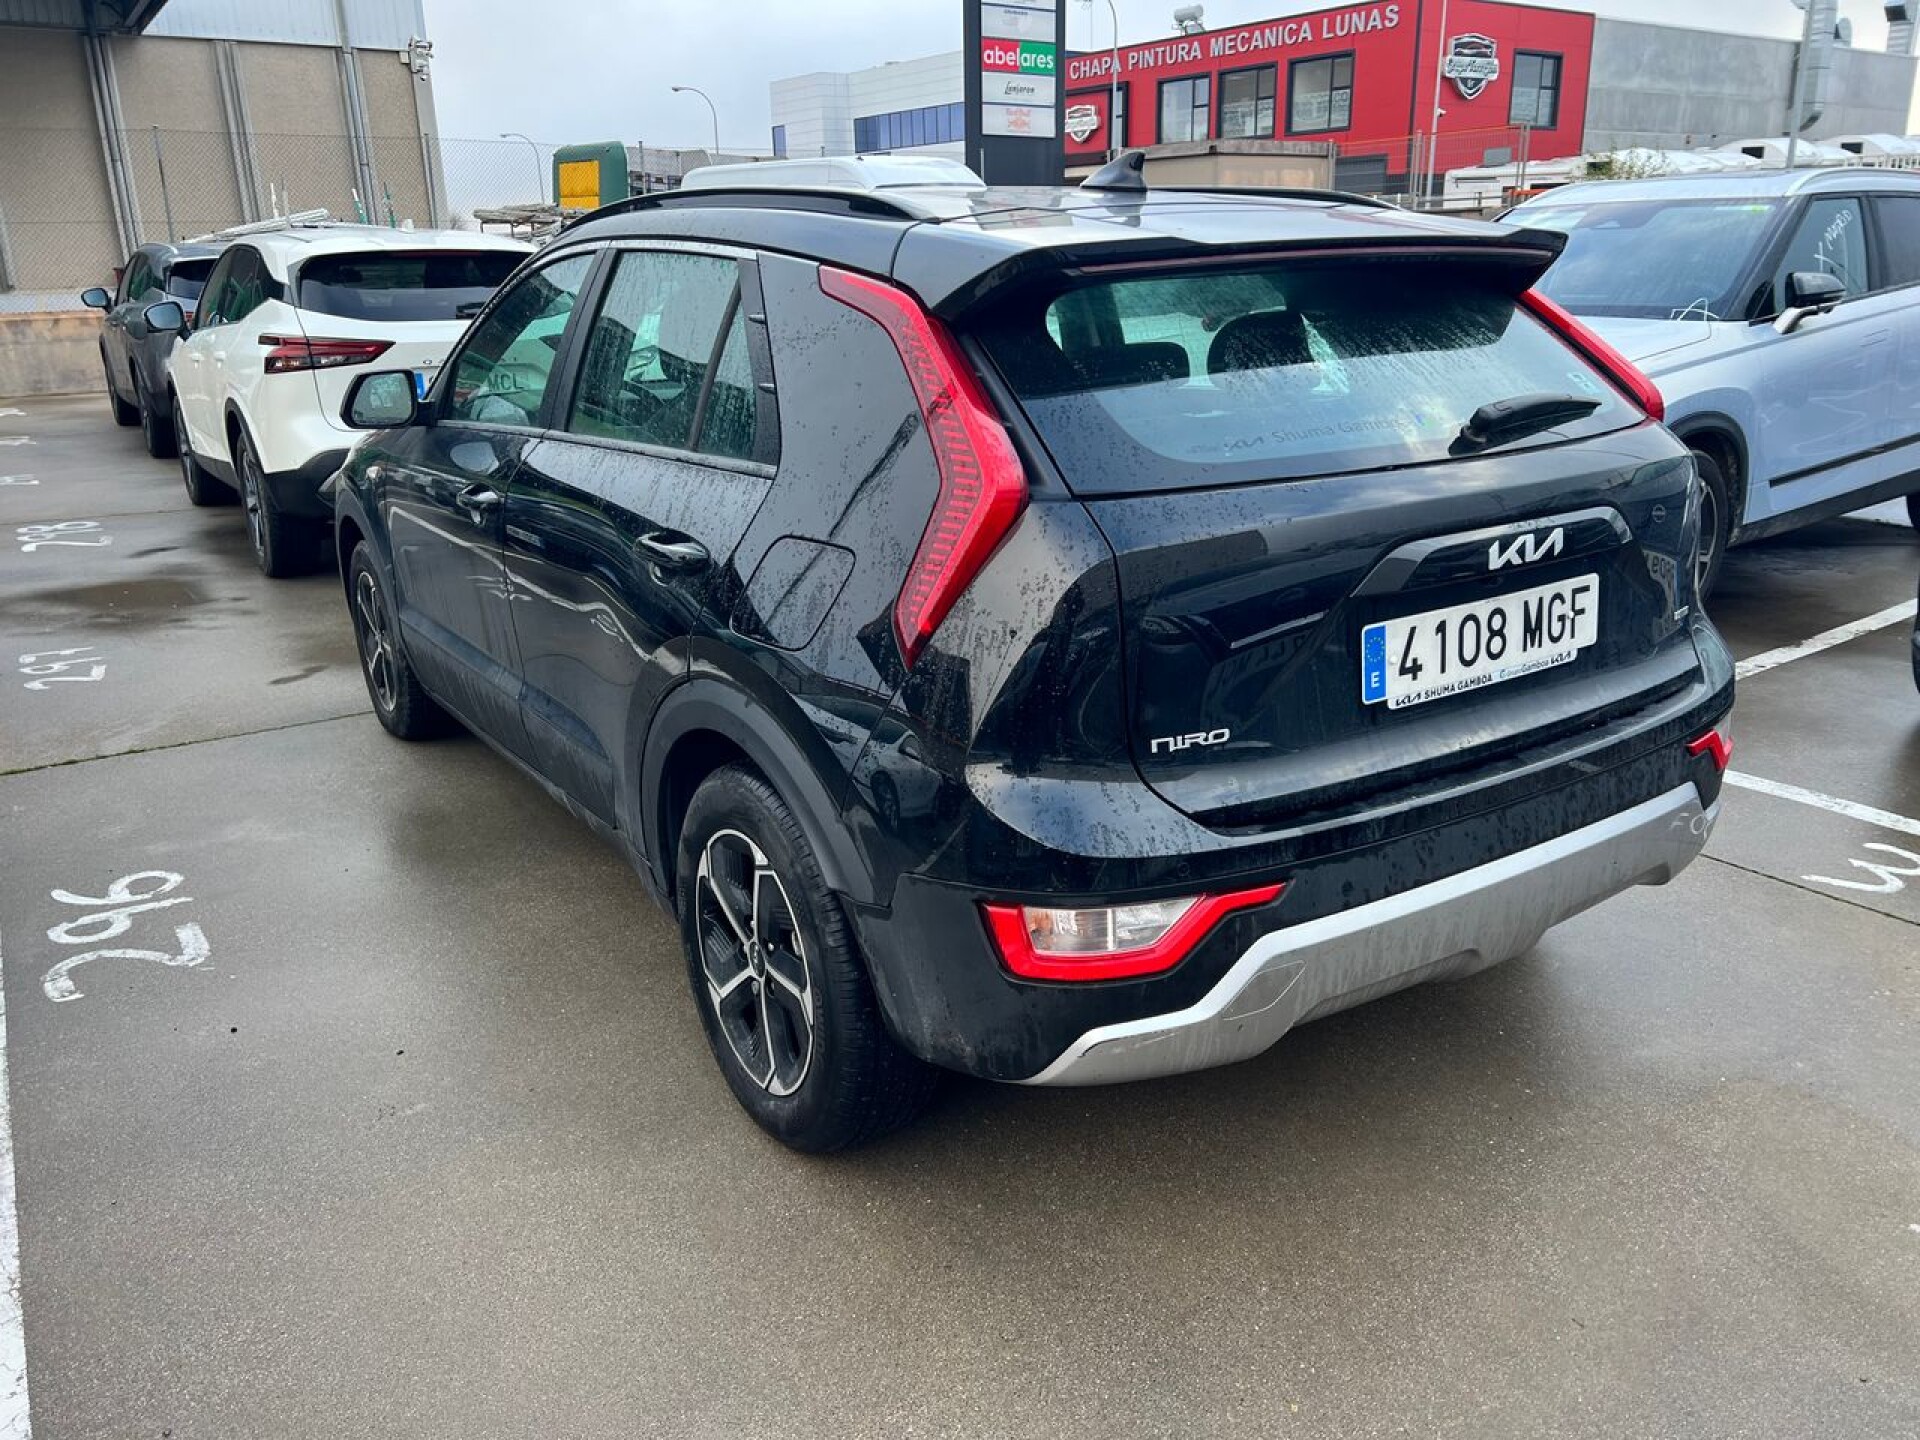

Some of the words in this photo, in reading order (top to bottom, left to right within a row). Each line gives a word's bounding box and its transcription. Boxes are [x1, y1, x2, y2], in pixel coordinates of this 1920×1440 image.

[1069, 56, 1122, 80] CHAPA
[1127, 41, 1202, 71] PINTURA
[1209, 21, 1313, 57] MECANICA
[1322, 4, 1400, 39] LUNAS
[984, 44, 1054, 69] abelares
[1271, 425, 1336, 443] Shuma
[1488, 527, 1564, 571] KIA
[1398, 607, 1508, 681] 4108
[1521, 585, 1591, 652] MGF
[1370, 671, 1380, 688] E
[1424, 683, 1456, 700] SHUMA
[1457, 674, 1493, 691] GAMBOA
[1150, 728, 1231, 754] NIRO
[40, 869, 213, 1004] 296
